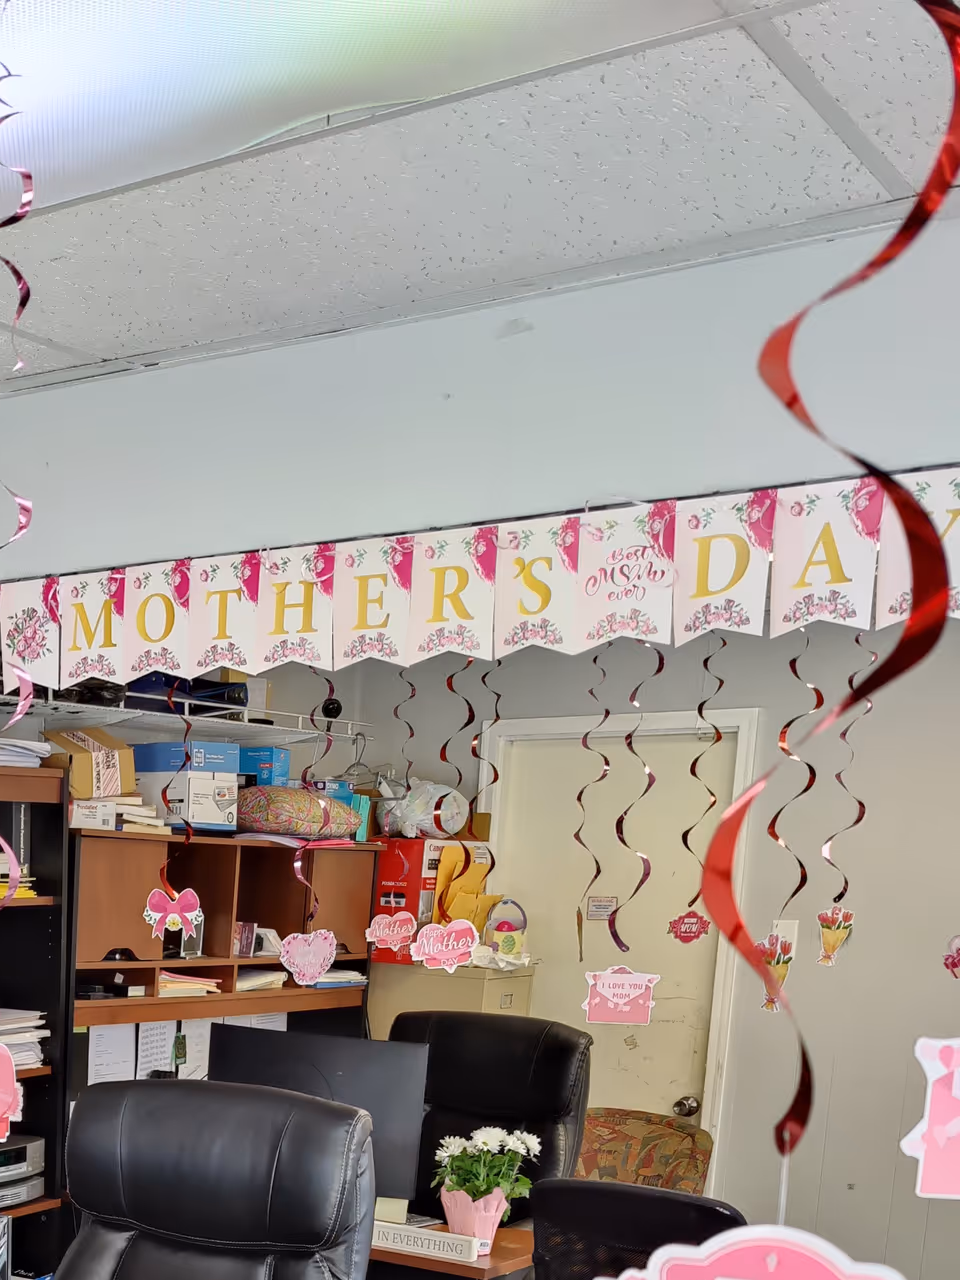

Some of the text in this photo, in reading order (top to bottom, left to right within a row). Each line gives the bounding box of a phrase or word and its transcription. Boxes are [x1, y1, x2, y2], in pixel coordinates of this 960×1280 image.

[606, 545, 653, 566] Best
[607, 584, 647, 602] ever
[372, 921, 413, 937] Mother
[422, 927, 448, 939] Happy
[420, 932, 475, 956] Mother
[440, 957, 458, 966] DAY
[612, 992, 631, 1000] MOM
[377, 1230, 464, 1256] IN EVERYTHING
